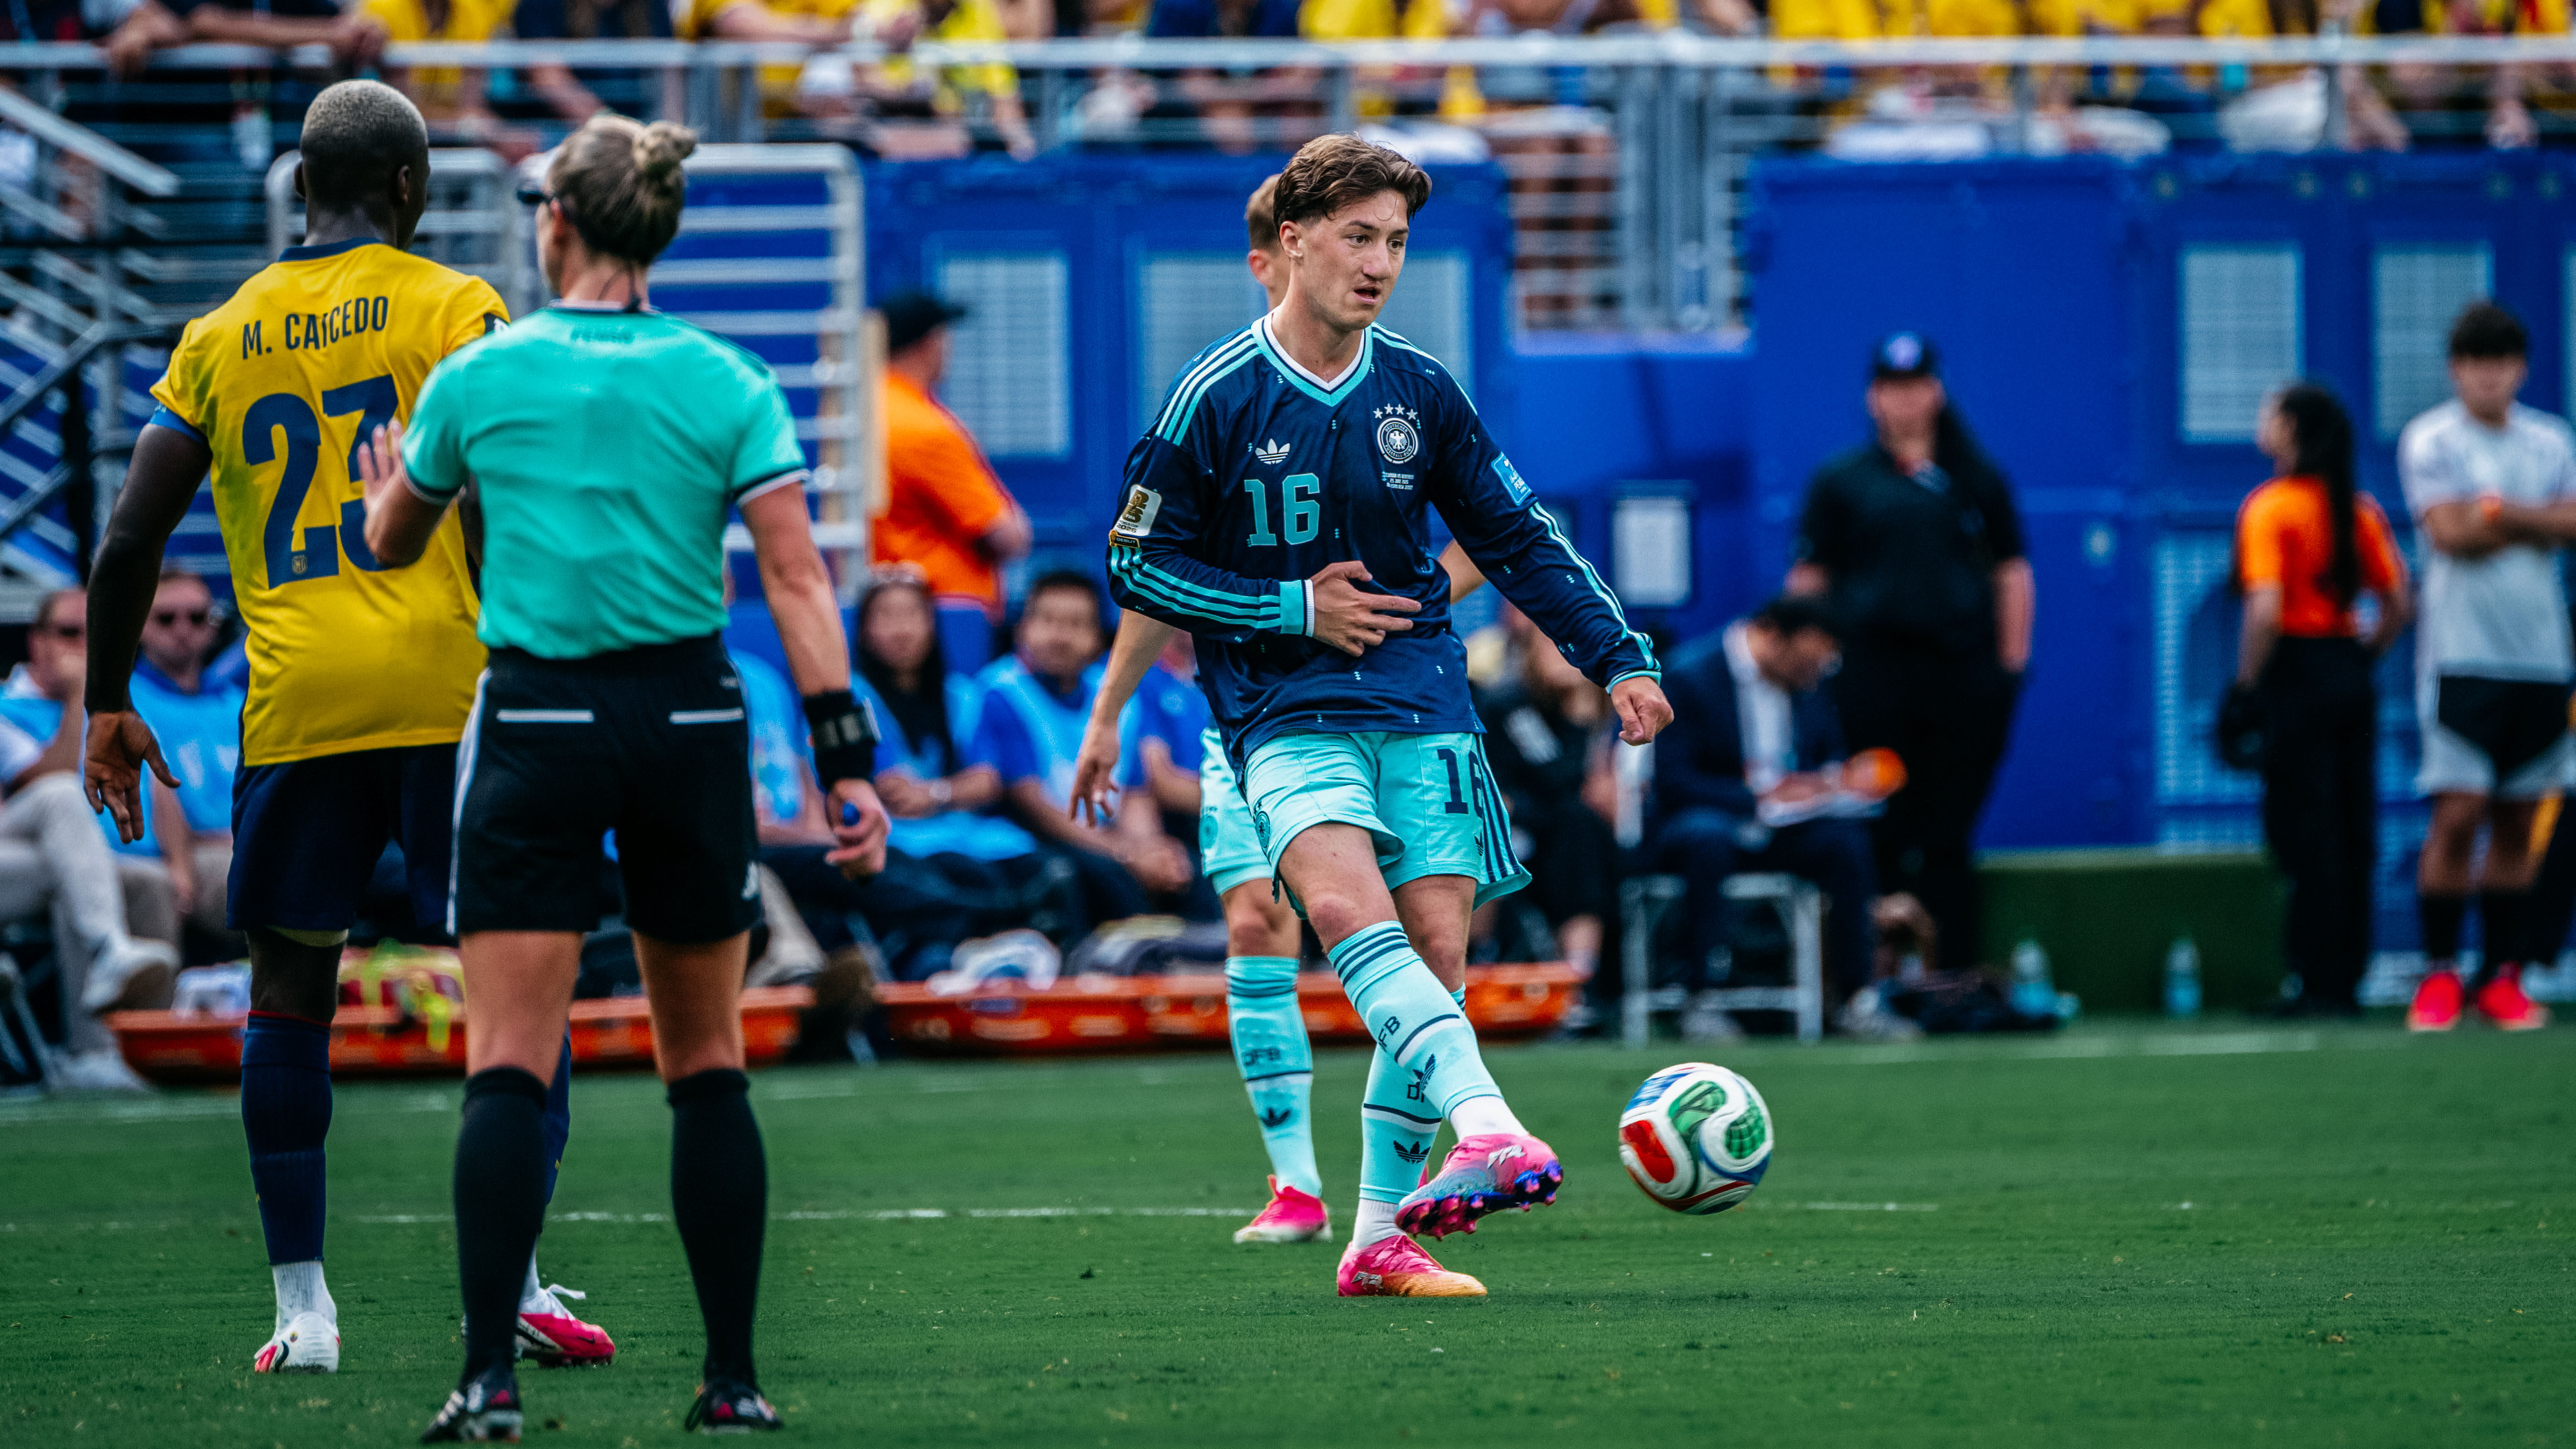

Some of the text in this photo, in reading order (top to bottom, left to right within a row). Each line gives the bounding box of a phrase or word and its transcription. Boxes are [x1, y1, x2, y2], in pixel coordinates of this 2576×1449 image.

[242, 296, 389, 360] M. CAICEDO
[1385, 424, 1408, 432] DEUTSCHER
[242, 373, 399, 590] 23
[1244, 473, 1320, 545] 16
[1117, 524, 1136, 533] 2026
[1377, 1016, 1401, 1053] FB
[1243, 1047, 1281, 1067] DFB
